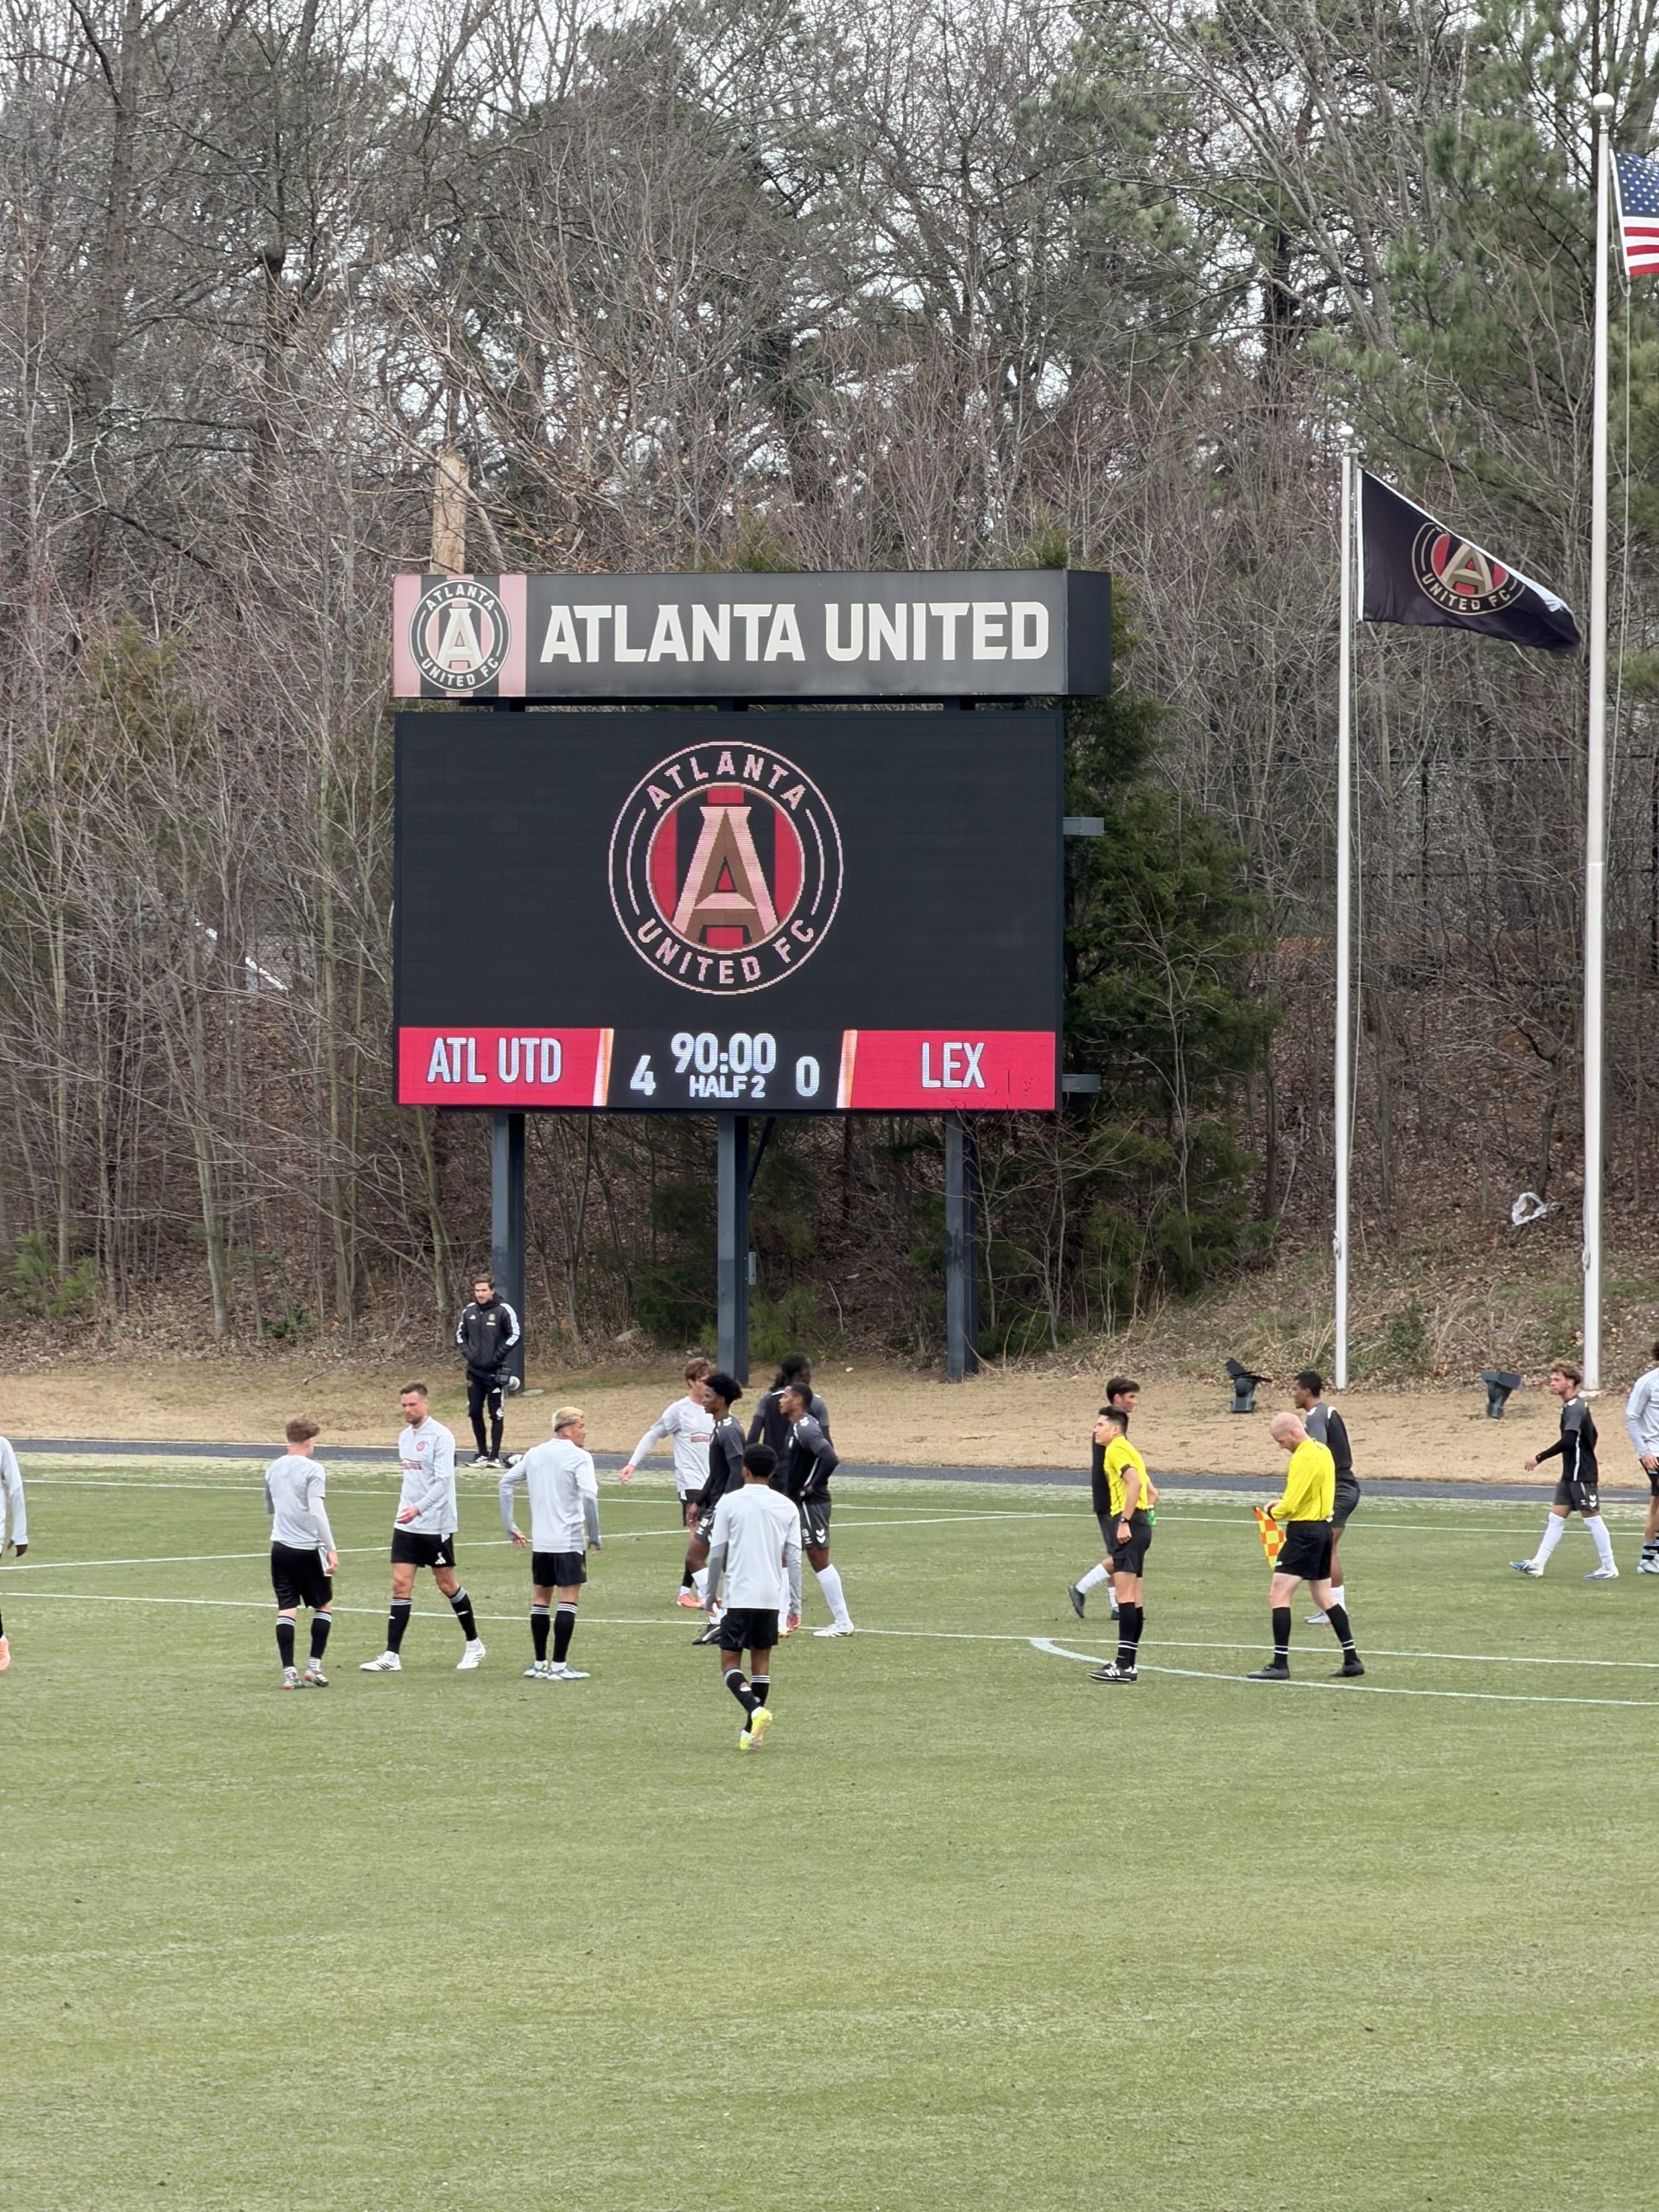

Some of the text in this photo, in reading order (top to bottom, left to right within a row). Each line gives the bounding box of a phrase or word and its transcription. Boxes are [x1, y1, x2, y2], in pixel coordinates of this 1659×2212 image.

[425, 584, 497, 611] ATLANTA
[1421, 573, 1510, 611] UNITED FC
[540, 601, 1049, 663] ATLANTA UNITED
[421, 658, 499, 687] UNITED FC
[645, 751, 807, 810] ATLANTA
[637, 917, 815, 984] UNITED FC
[427, 1037, 562, 1084] ATL UTD
[671, 1033, 777, 1074] 90:00
[922, 1042, 986, 1089] LEX
[629, 1054, 657, 1096] 4
[689, 1075, 766, 1098] HALF 2
[795, 1055, 820, 1097] 0
